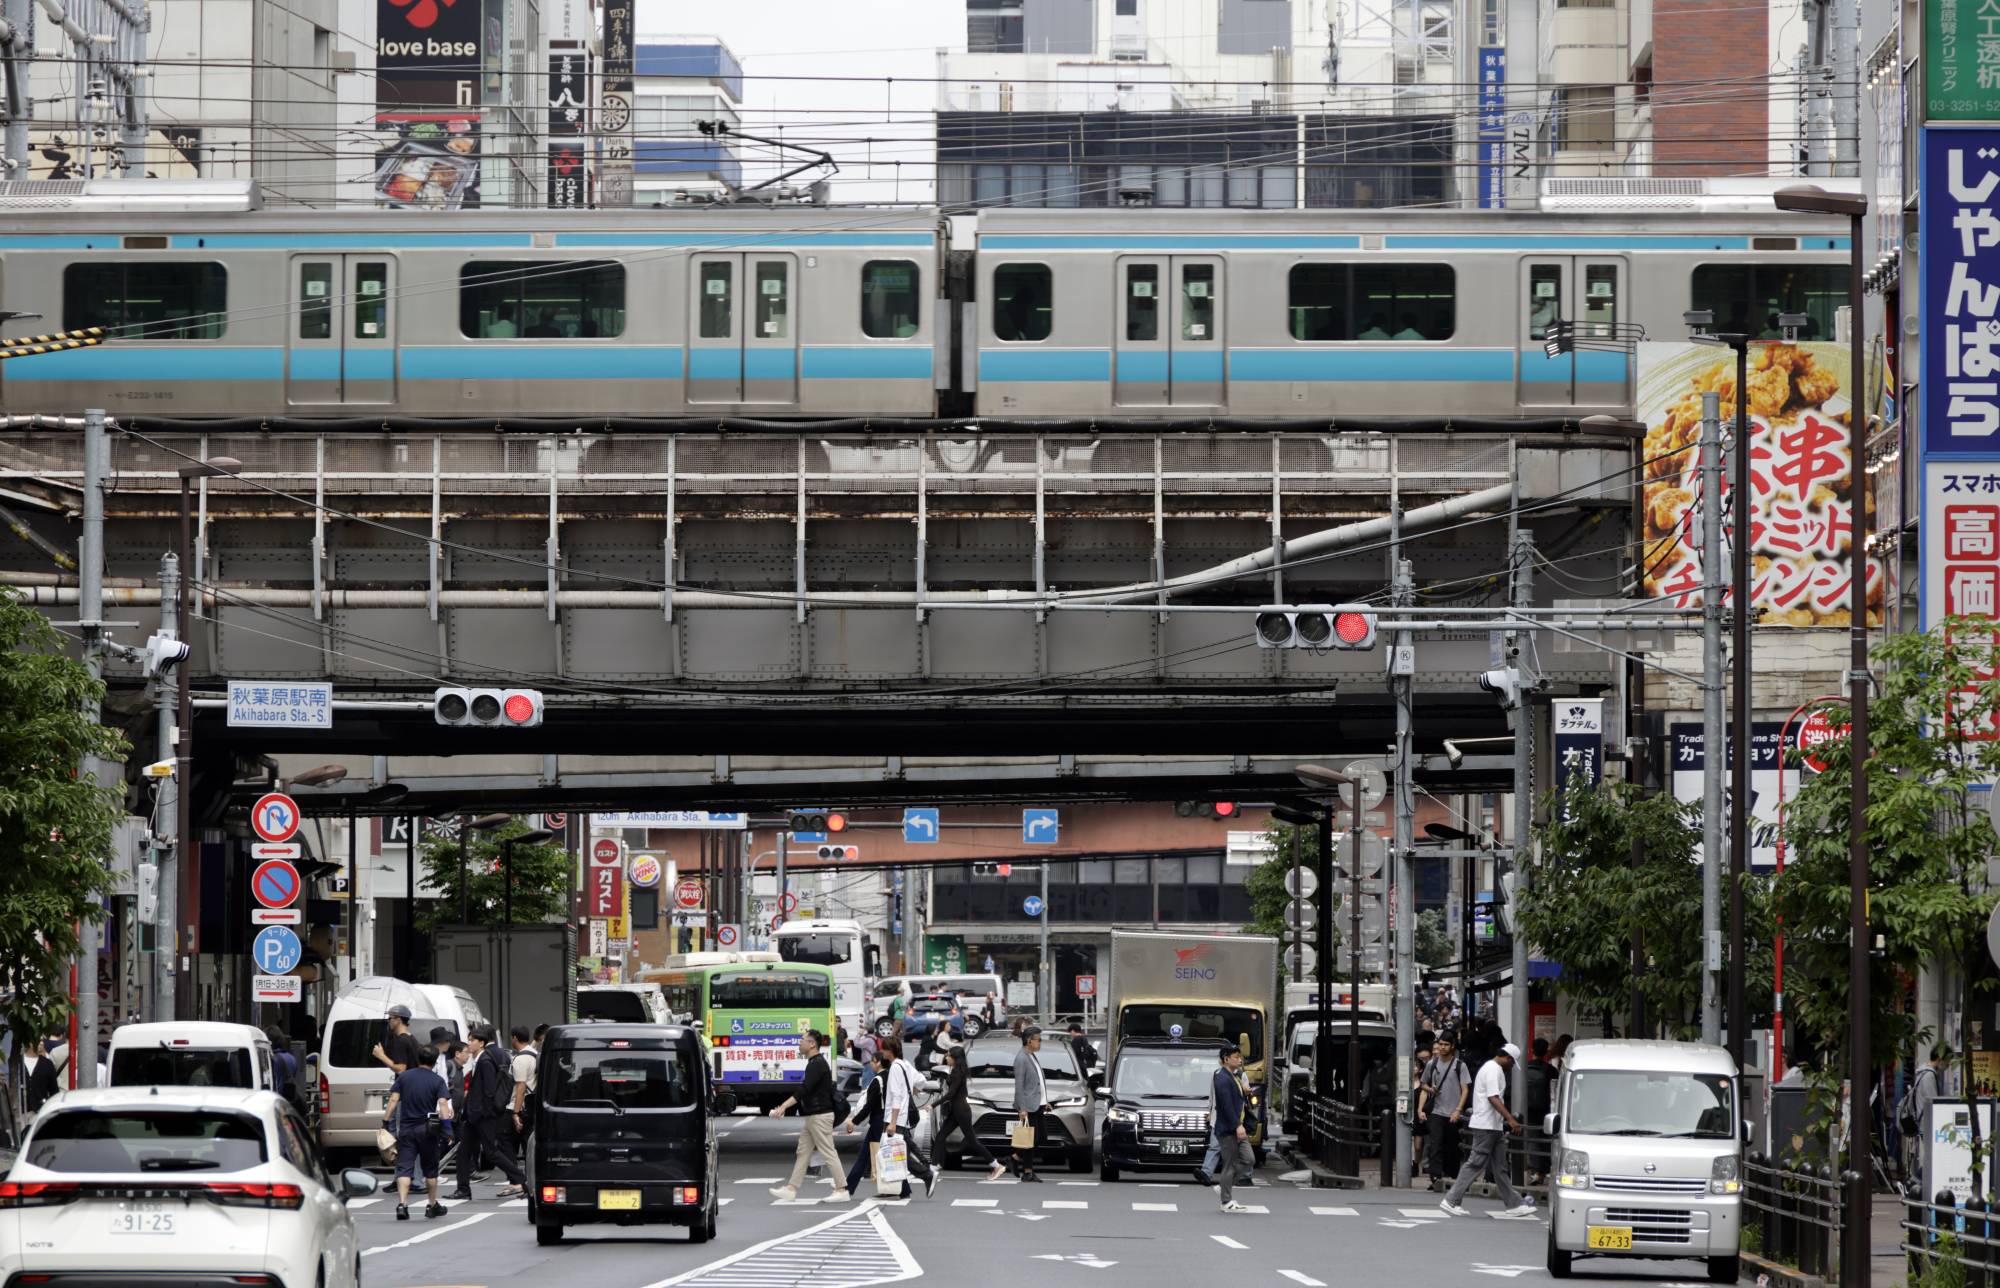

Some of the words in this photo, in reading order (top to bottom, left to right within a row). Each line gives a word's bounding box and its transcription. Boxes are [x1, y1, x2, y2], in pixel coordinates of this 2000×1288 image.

[377, 37, 424, 56] love
[427, 37, 477, 56] base
[1944, 147, 2000, 436] じゃんぱら
[233, 687, 327, 707] 秋葉原駅南
[234, 708, 286, 721] Akihabara
[1810, 717, 1824, 726] FIRE
[598, 868, 613, 914] ガスト
[265, 939, 282, 969] P
[276, 955, 290, 969] 60
[1175, 967, 1217, 980] SEINO
[124, 1214, 173, 1231] 91-25
[1598, 1236, 1630, 1248] 67-33
